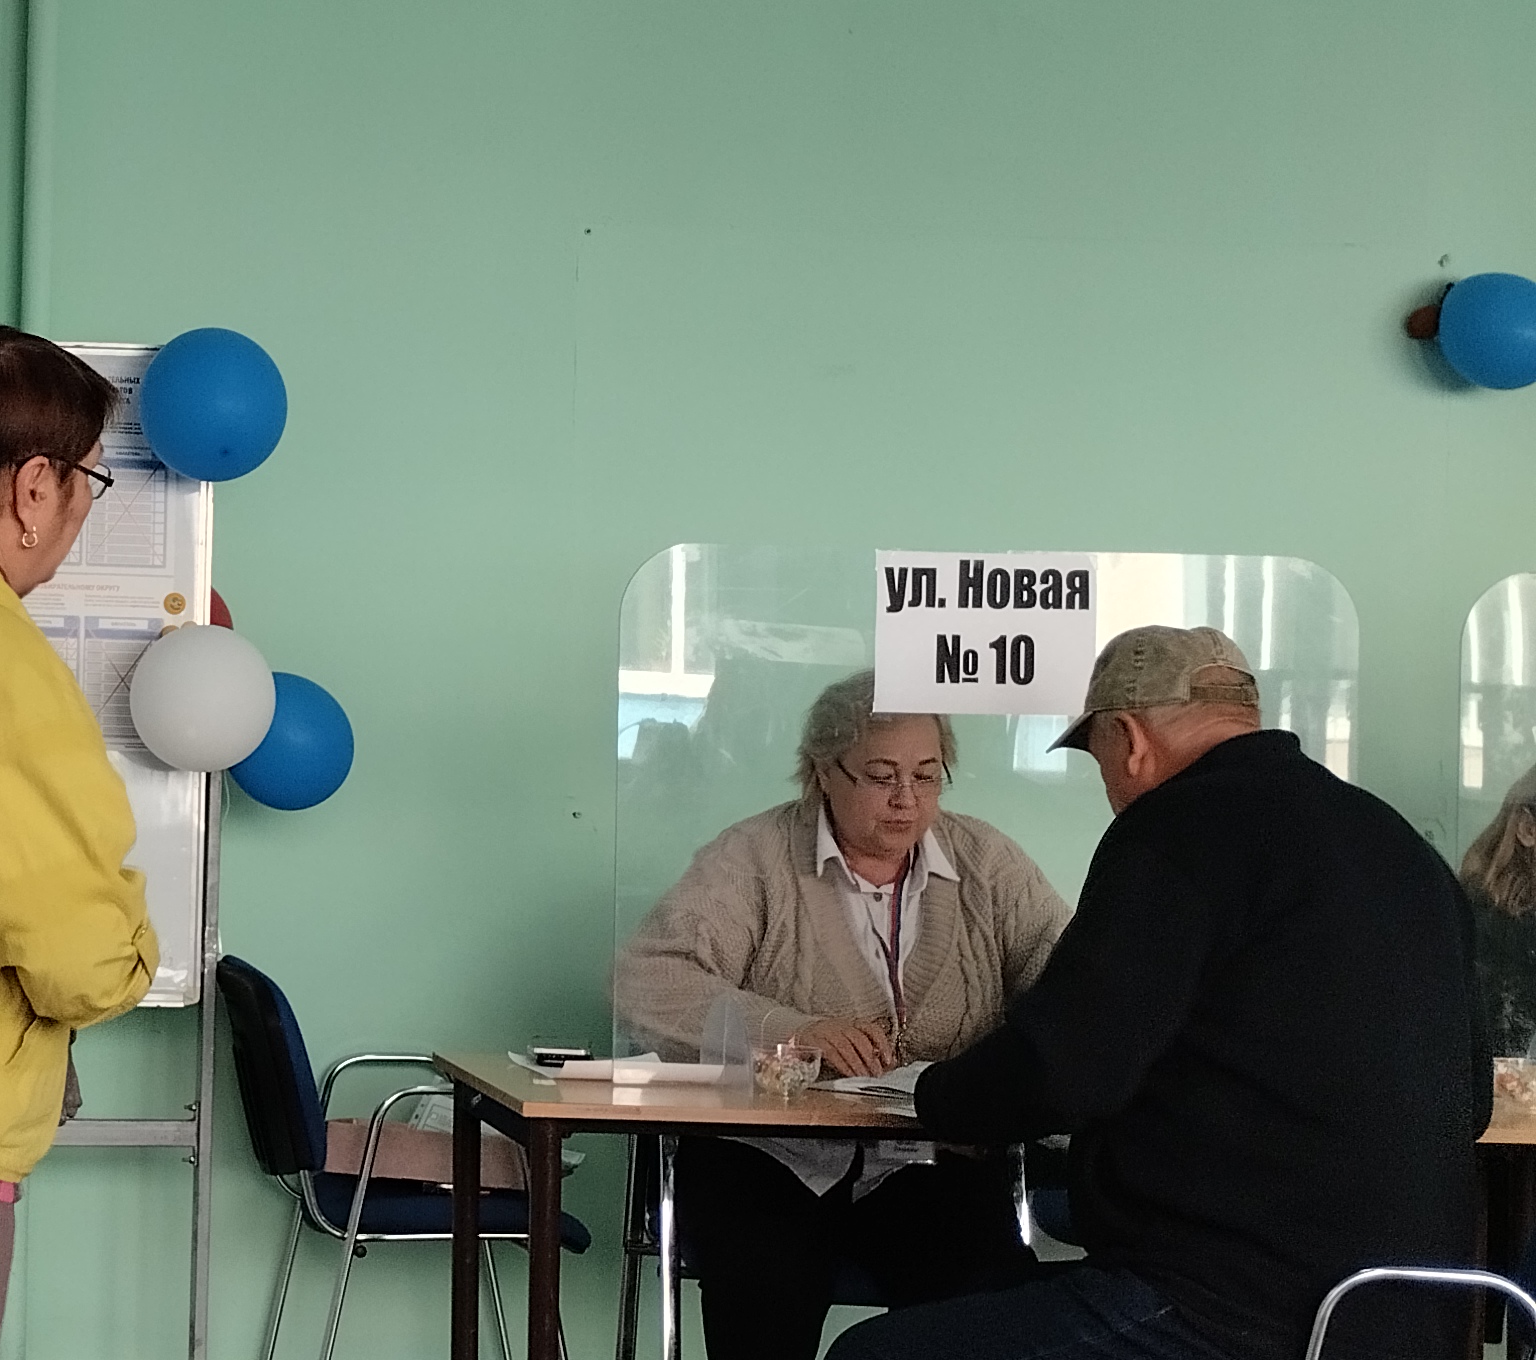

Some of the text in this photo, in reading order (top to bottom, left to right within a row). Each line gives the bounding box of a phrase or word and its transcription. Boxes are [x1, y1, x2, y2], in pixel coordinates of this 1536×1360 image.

[884, 559, 1089, 613] ул. Новая
[936, 634, 1035, 685] № 10
